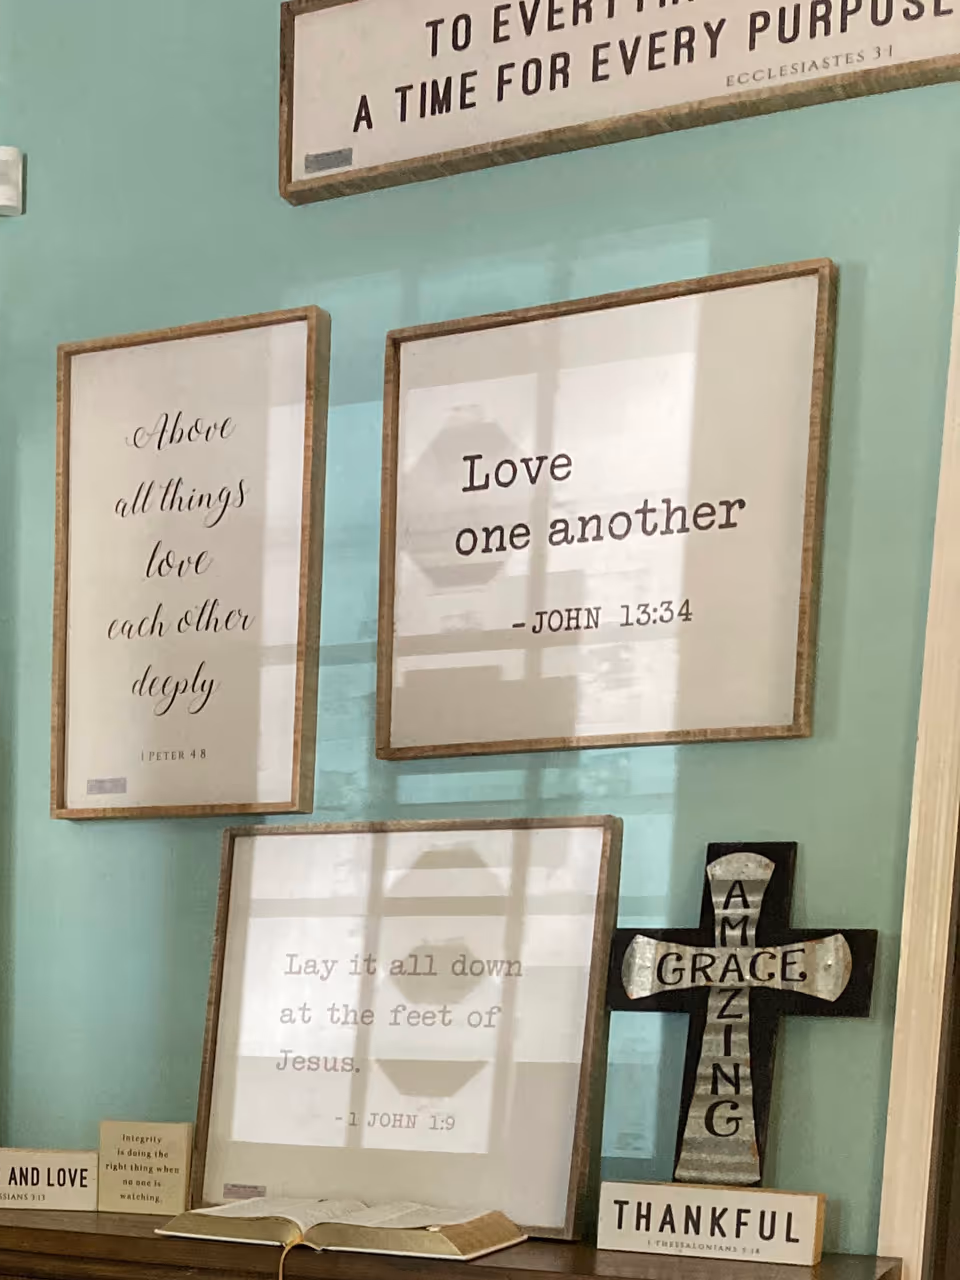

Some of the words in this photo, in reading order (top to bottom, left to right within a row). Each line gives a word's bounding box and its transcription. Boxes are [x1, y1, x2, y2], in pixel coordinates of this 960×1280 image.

[425, 13, 471, 57] TO
[353, 95, 373, 132] A
[395, 70, 478, 122] TIME
[497, 52, 570, 102] FOR
[592, 18, 726, 82] EVERY
[726, 49, 865, 87] ECCLESIASTES
[126, 410, 236, 450] Above
[462, 453, 572, 492] Love
[115, 480, 155, 517] all
[159, 477, 250, 528] things
[455, 522, 531, 555] one
[548, 498, 746, 546] another
[146, 540, 214, 578] love
[108, 603, 169, 640] each
[177, 598, 255, 633] other
[619, 598, 693, 627] 13:34
[132, 660, 221, 716] deeply
[148, 750, 185, 761] PETER
[284, 953, 338, 981] Lay
[348, 953, 377, 976] it
[389, 954, 438, 976] all
[451, 954, 523, 977] down
[656, 949, 807, 985] GRACE
[280, 1002, 312, 1025] at
[327, 1004, 375, 1026] the
[388, 1004, 452, 1027] feet
[467, 1006, 502, 1028] of
[276, 1050, 361, 1074] Jesus.
[122, 1133, 162, 1144] Integrity
[368, 1113, 418, 1129] JOHN
[428, 1115, 456, 1131] 1:9
[105, 1162, 127, 1171] right
[130, 1163, 153, 1174] thing
[156, 1165, 180, 1174] when
[117, 1147, 124, 1155] is
[127, 1148, 151, 1159] doing
[155, 1149, 169, 1158] the
[8, 1166, 40, 1186] AND
[47, 1167, 89, 1188] LOVE
[614, 1199, 800, 1243] THANKFUL
